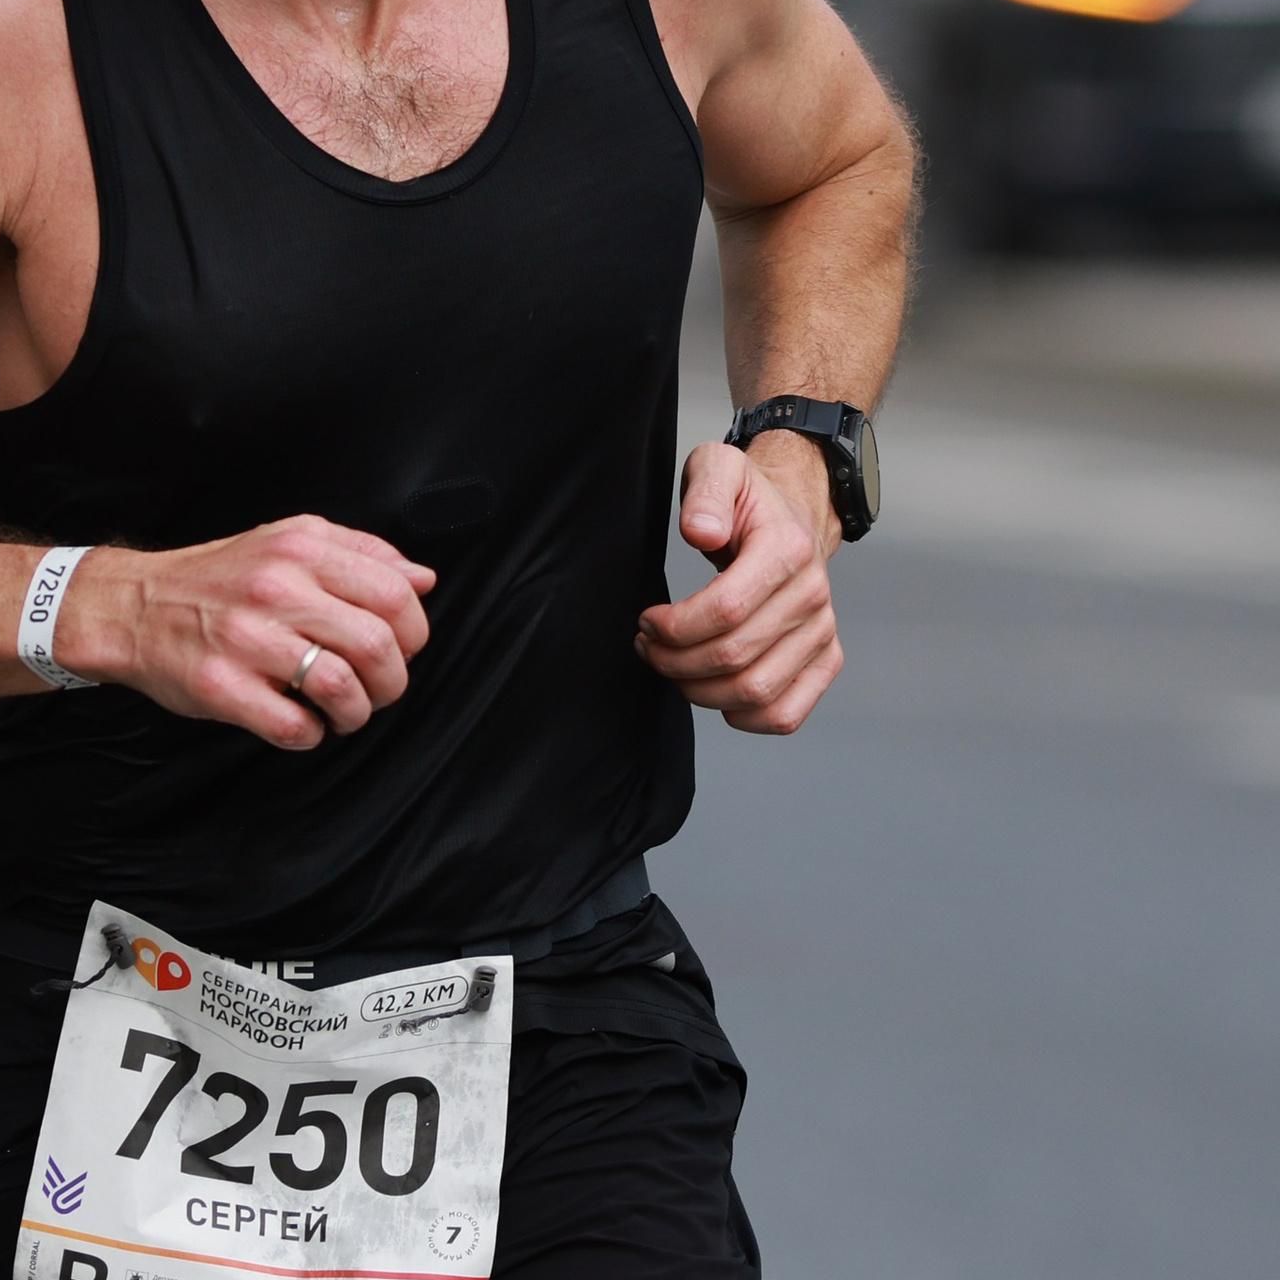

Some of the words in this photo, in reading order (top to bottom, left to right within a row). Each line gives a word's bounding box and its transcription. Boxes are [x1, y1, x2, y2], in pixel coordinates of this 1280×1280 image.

[29, 566, 67, 623] 7250
[201, 983, 348, 1034] МОСКОВСКИЙ
[203, 970, 312, 1016] СБЕРПРАЙМ
[372, 991, 415, 1013] 42,2
[423, 983, 455, 1004] КМ
[200, 999, 305, 1050] МАРАФОН
[115, 1028, 440, 1196] 7250
[186, 1198, 328, 1242] СЕРГЕЙ
[446, 1226, 462, 1244] 7
[29, 1240, 40, 1270] CORRAL
